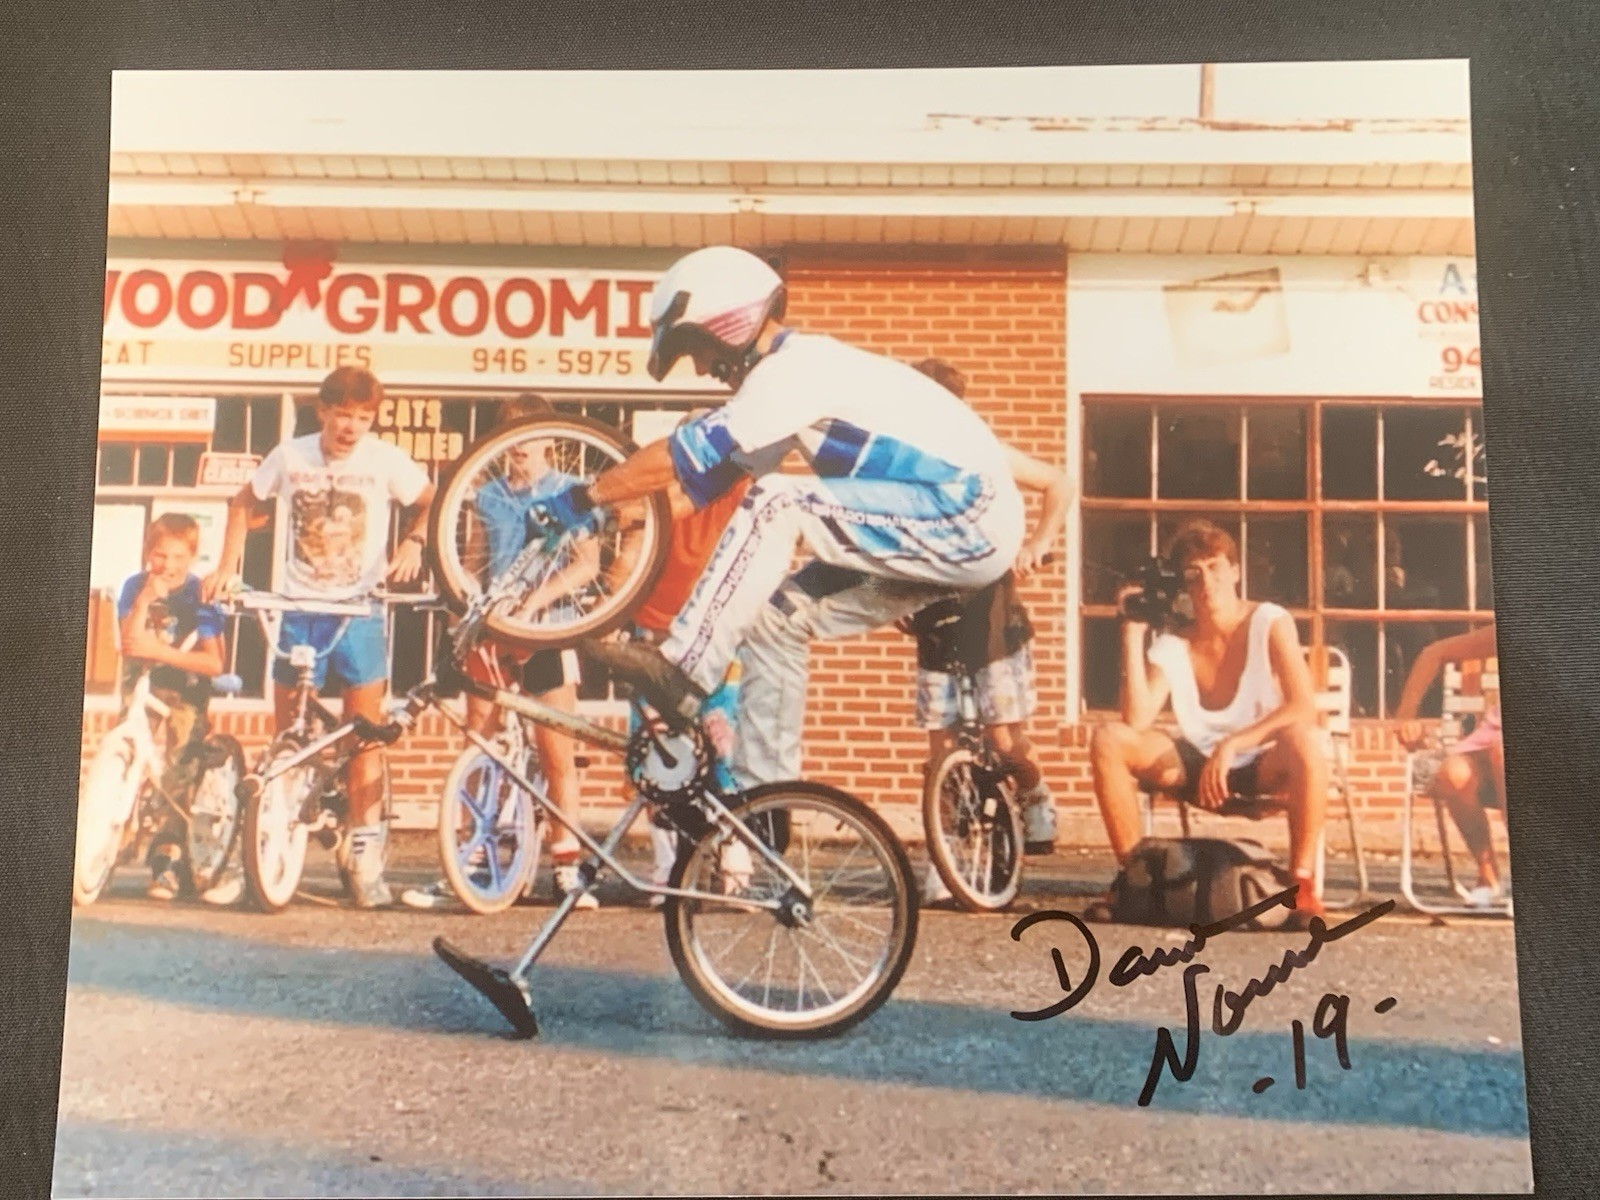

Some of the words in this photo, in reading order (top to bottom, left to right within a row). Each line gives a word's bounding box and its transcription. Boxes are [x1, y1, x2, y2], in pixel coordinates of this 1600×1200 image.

[229, 342, 372, 369] SUPPLIES
[472, 348, 527, 374] 946
[557, 350, 633, 375] 5975
[377, 398, 442, 429] CATS
